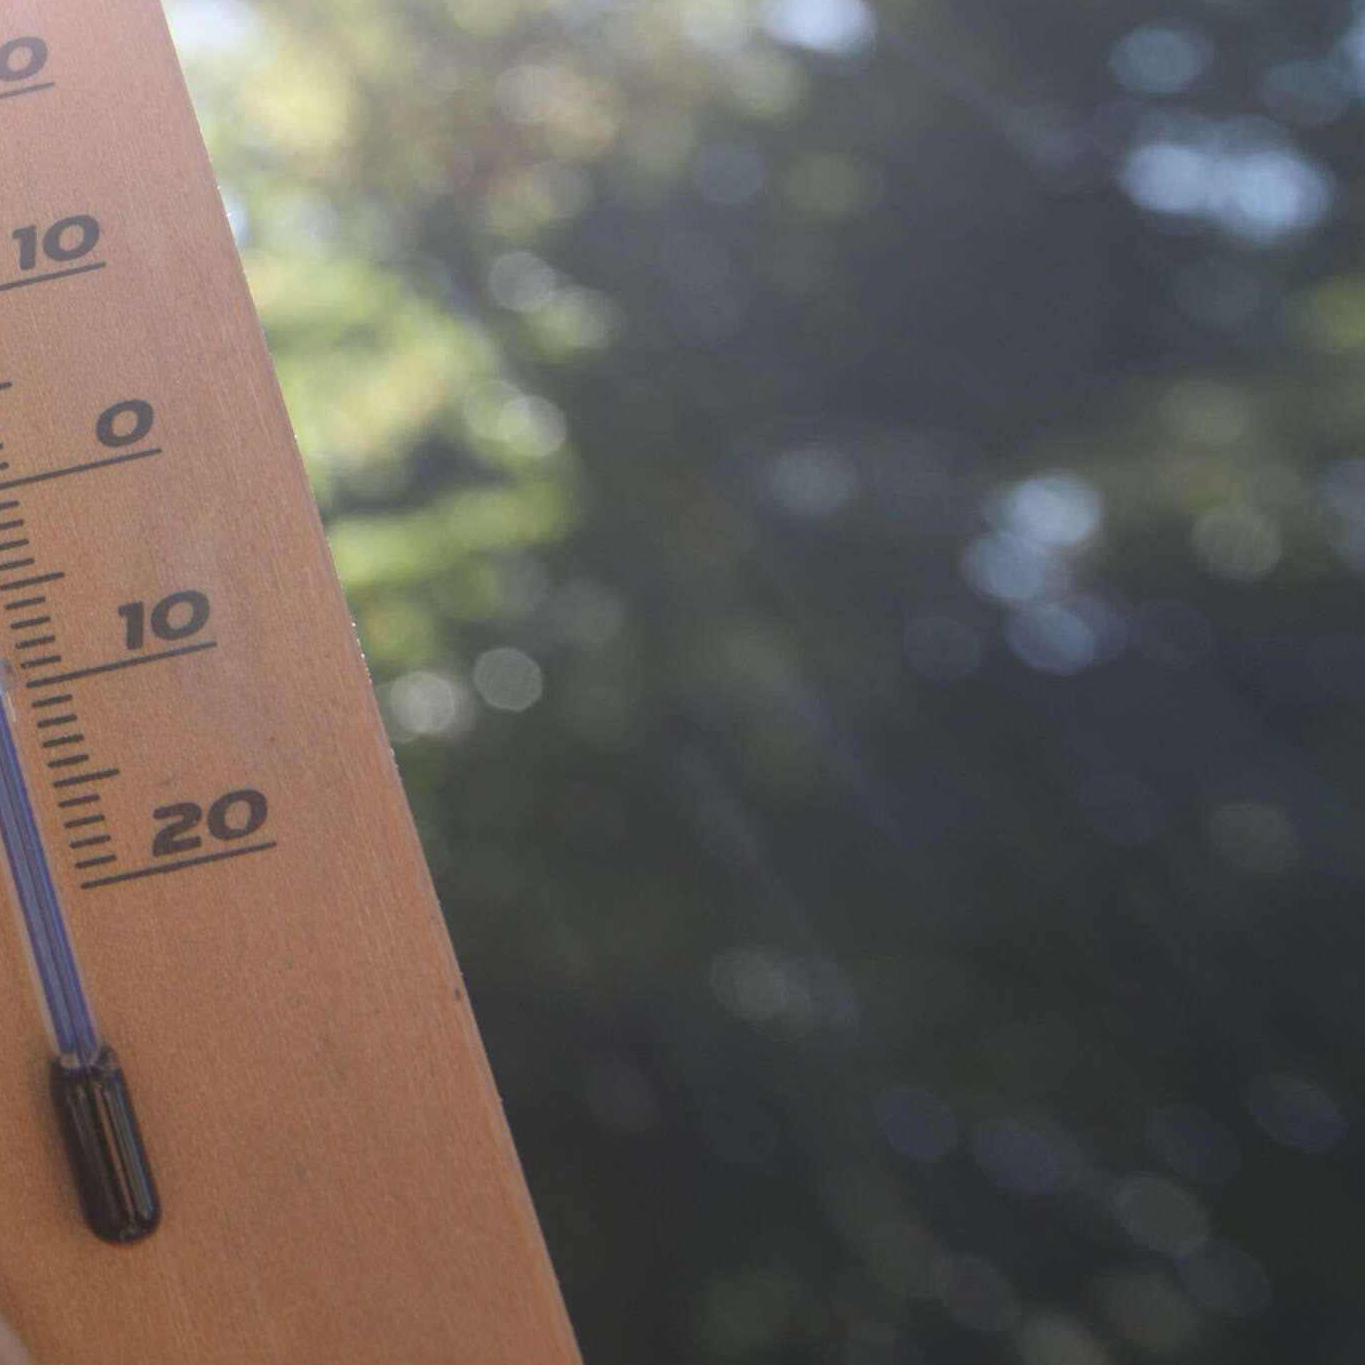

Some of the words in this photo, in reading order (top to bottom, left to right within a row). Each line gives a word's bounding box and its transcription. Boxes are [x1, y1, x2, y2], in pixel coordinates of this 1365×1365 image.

[11, 214, 100, 270] 10
[95, 399, 154, 448] 0
[118, 590, 210, 650] 10
[150, 789, 268, 857] 20
